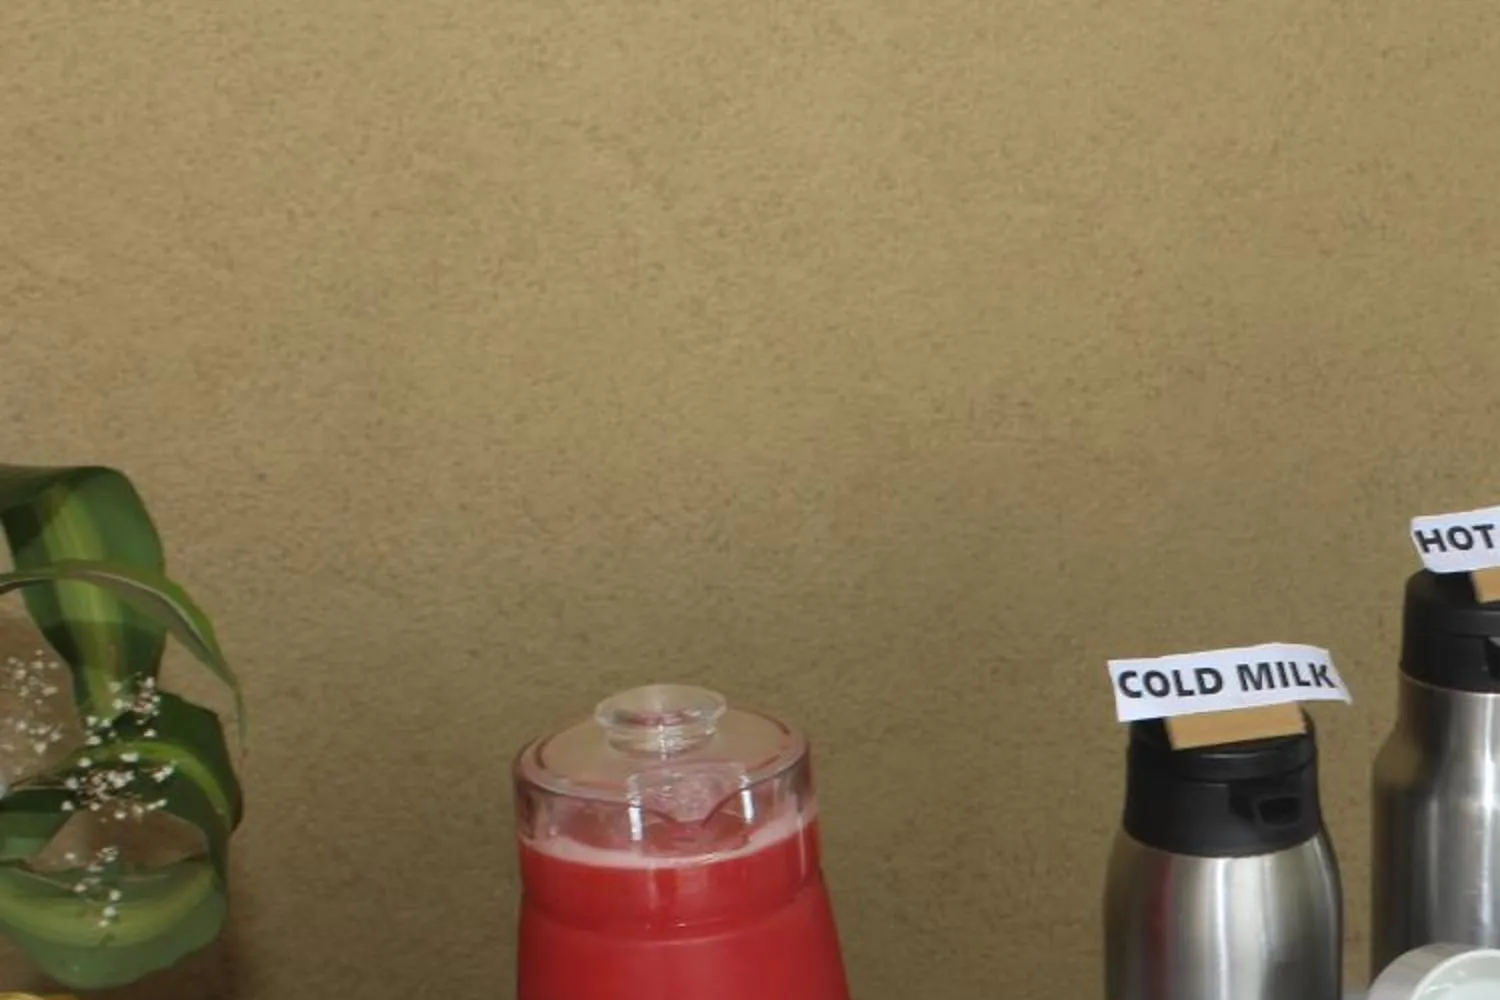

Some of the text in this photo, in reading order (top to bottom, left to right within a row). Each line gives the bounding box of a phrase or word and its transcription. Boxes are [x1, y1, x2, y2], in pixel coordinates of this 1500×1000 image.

[1414, 523, 1497, 555] HOT
[1117, 660, 1336, 700] COLD MILK
